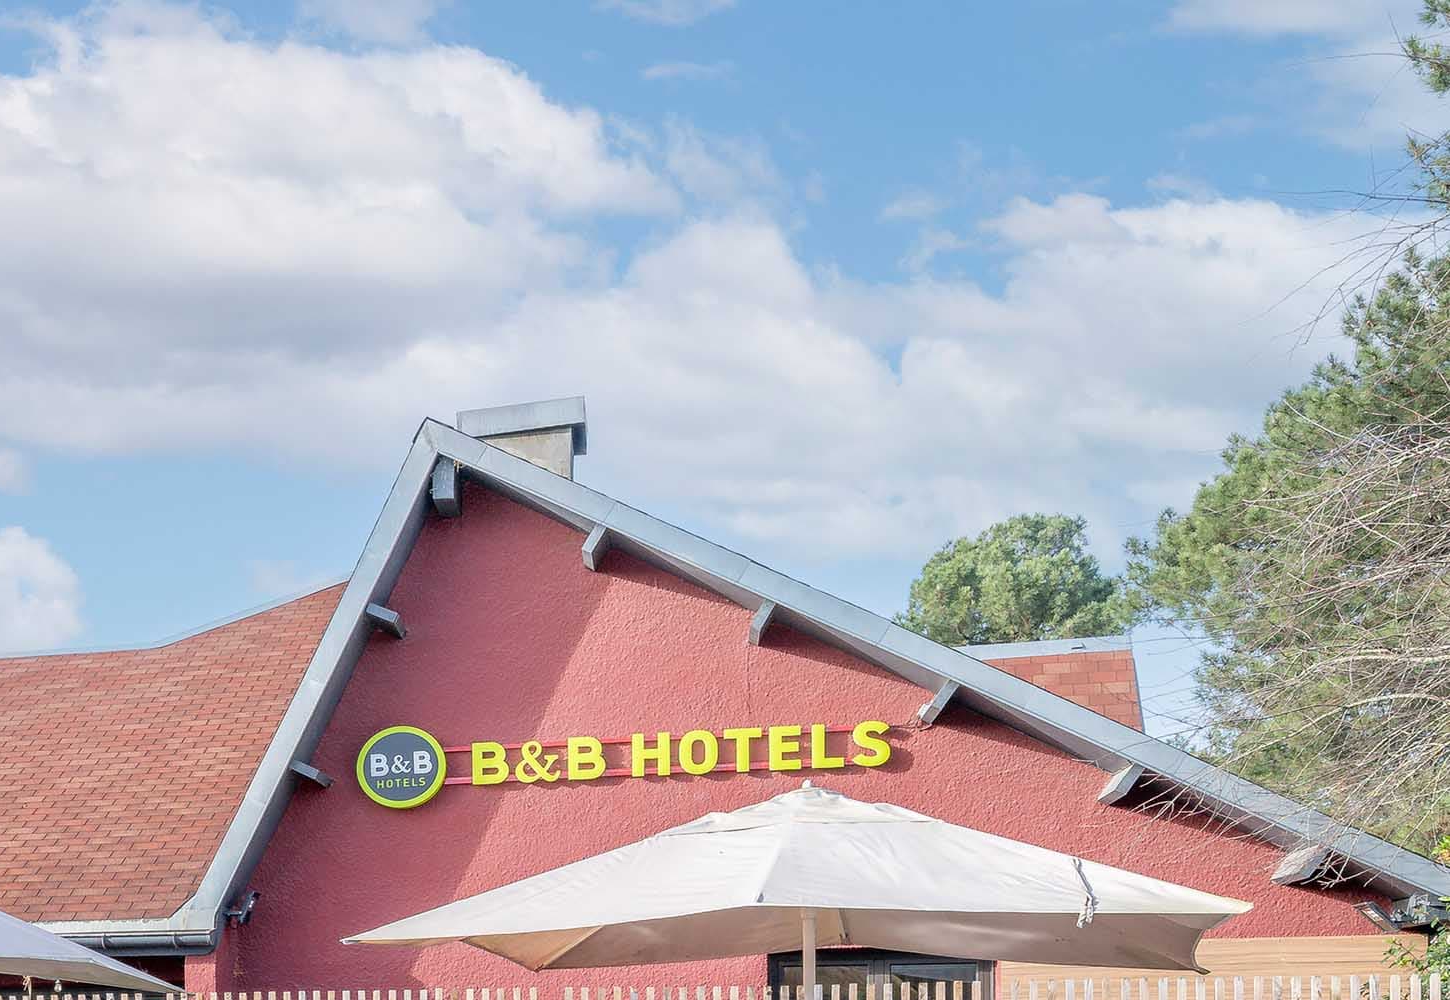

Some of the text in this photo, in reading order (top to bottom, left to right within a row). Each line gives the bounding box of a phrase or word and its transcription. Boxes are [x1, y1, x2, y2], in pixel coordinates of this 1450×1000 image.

[370, 750, 433, 777] B&B
[471, 720, 891, 785] B&B HOTELS
[376, 777, 426, 789] HOTELS
